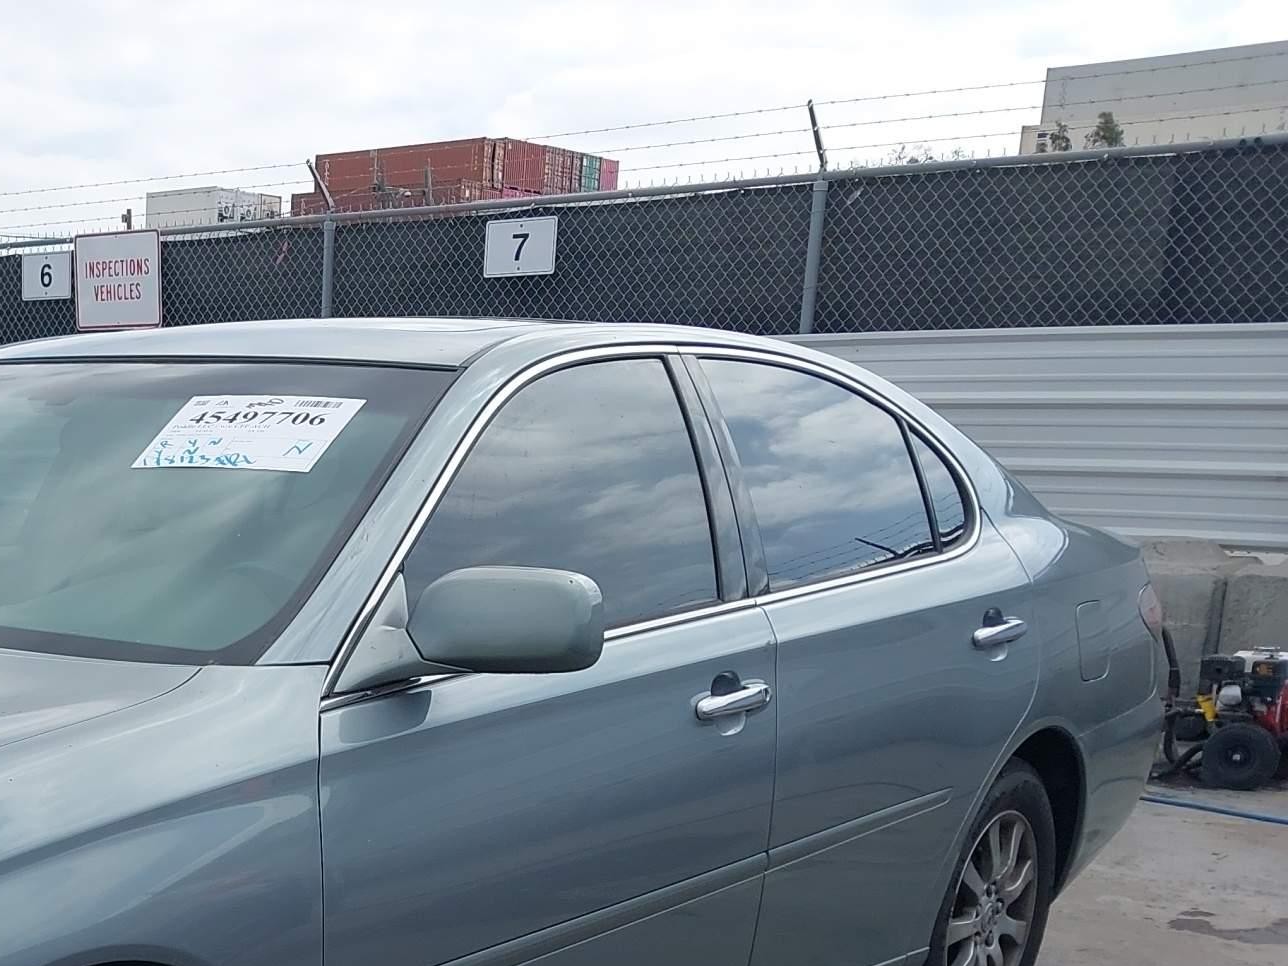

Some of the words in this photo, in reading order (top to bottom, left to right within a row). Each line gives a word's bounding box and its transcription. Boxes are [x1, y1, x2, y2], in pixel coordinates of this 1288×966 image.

[512, 233, 530, 261] 7
[41, 264, 52, 288] 6
[85, 258, 150, 279] INSPECTIONS
[94, 283, 142, 301] VEHICLES
[189, 410, 328, 426] 45497706
